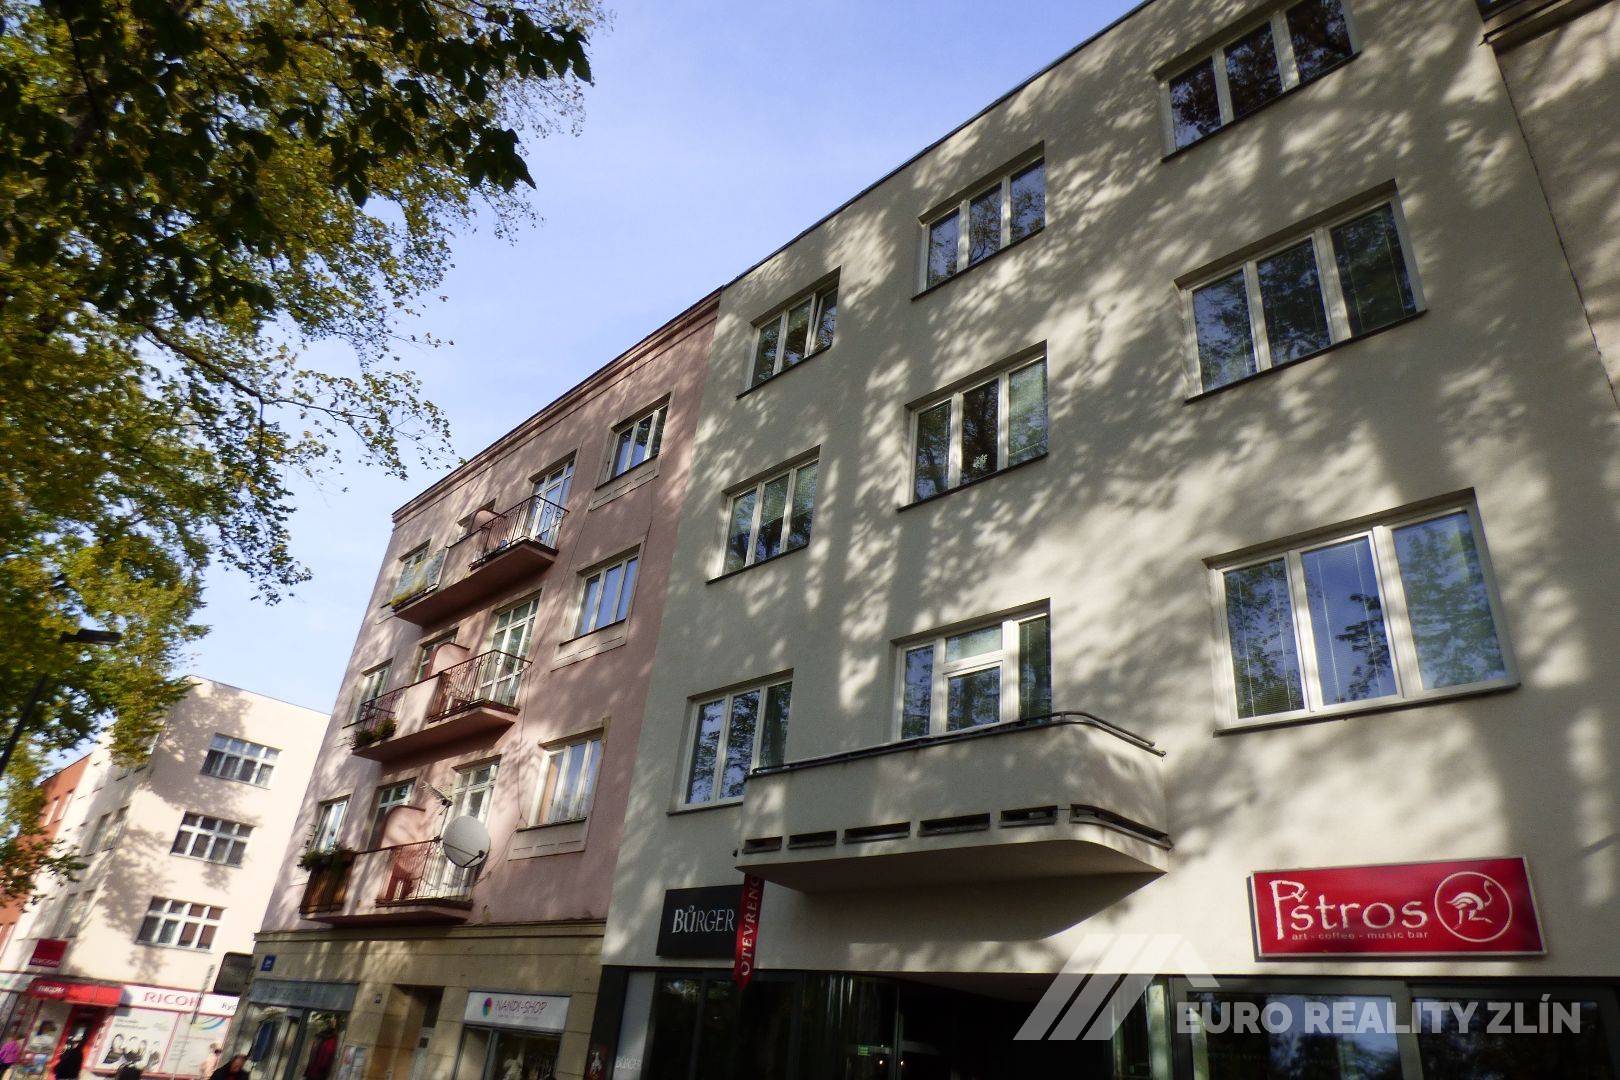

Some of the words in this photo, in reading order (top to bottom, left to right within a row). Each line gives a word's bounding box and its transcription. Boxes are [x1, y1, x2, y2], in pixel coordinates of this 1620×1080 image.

[1291, 932, 1308, 941] art
[1367, 930, 1404, 940] music
[1407, 930, 1429, 939] bar
[143, 991, 199, 1006] RICOH
